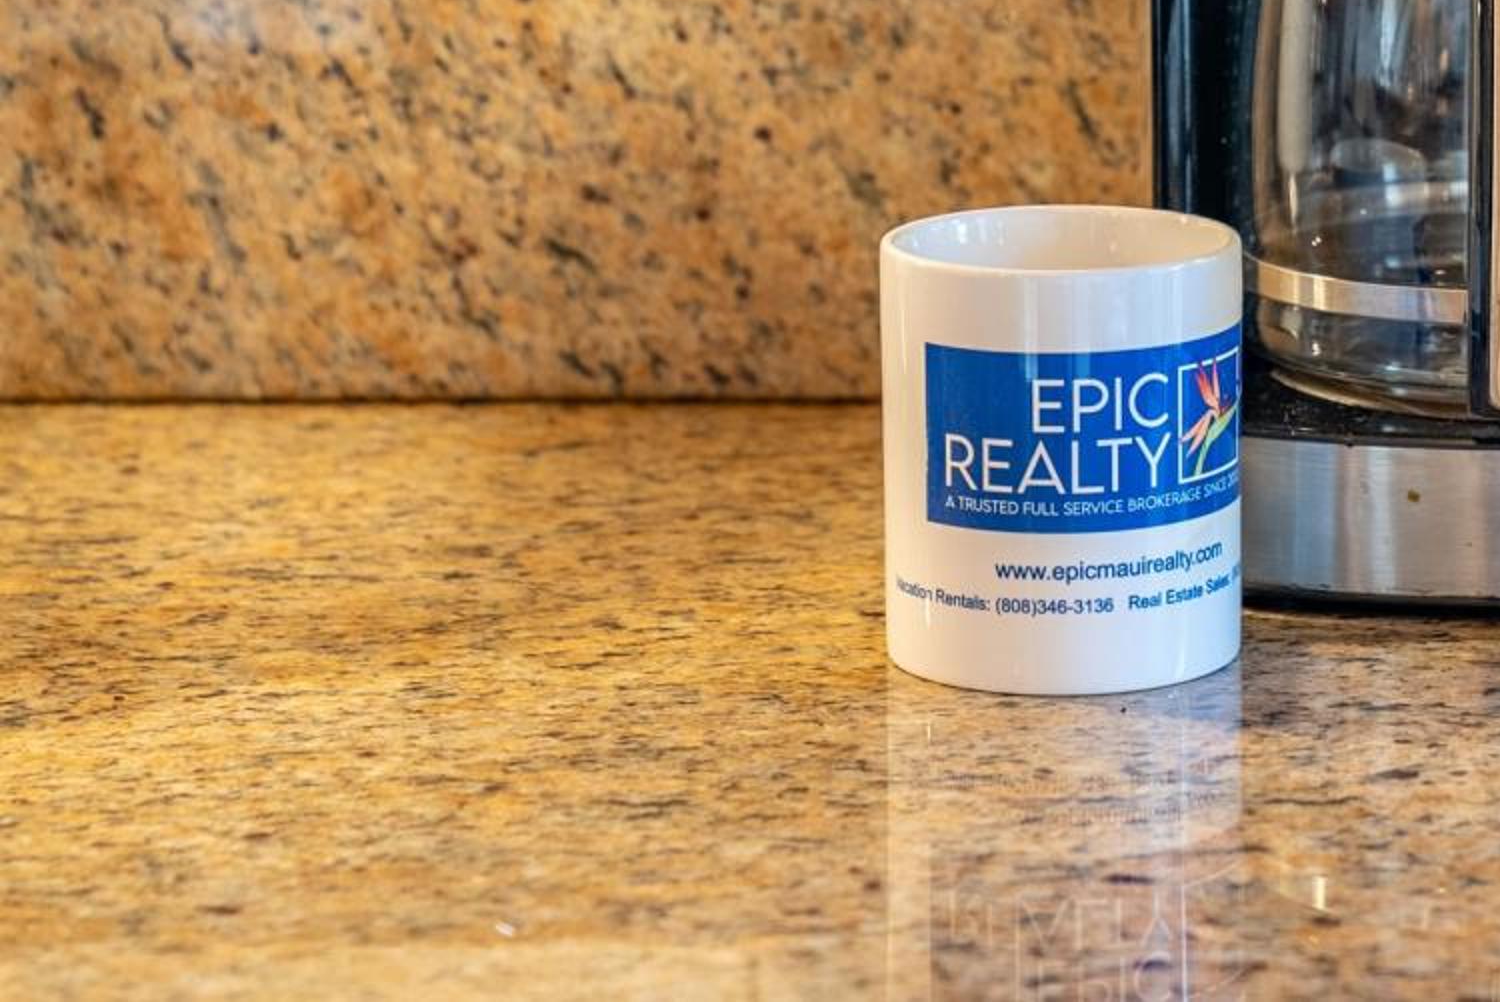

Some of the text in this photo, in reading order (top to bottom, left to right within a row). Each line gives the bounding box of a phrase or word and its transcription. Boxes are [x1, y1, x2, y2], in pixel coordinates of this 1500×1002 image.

[1032, 373, 1169, 434] EPIC
[944, 432, 1171, 494] REALTY
[945, 495, 955, 509] A
[958, 496, 1019, 515] TRUSTED
[1023, 501, 1059, 516] FULL
[1063, 499, 1124, 517] SERVICE
[1127, 486, 1201, 512] BROKERAGE
[995, 542, 1223, 584] www.epicmauirealty.com
[936, 588, 990, 611] Rentals:
[995, 597, 1115, 616] (808)346-3136
[1128, 592, 1162, 609] Real
[1166, 584, 1203, 604] Estate
